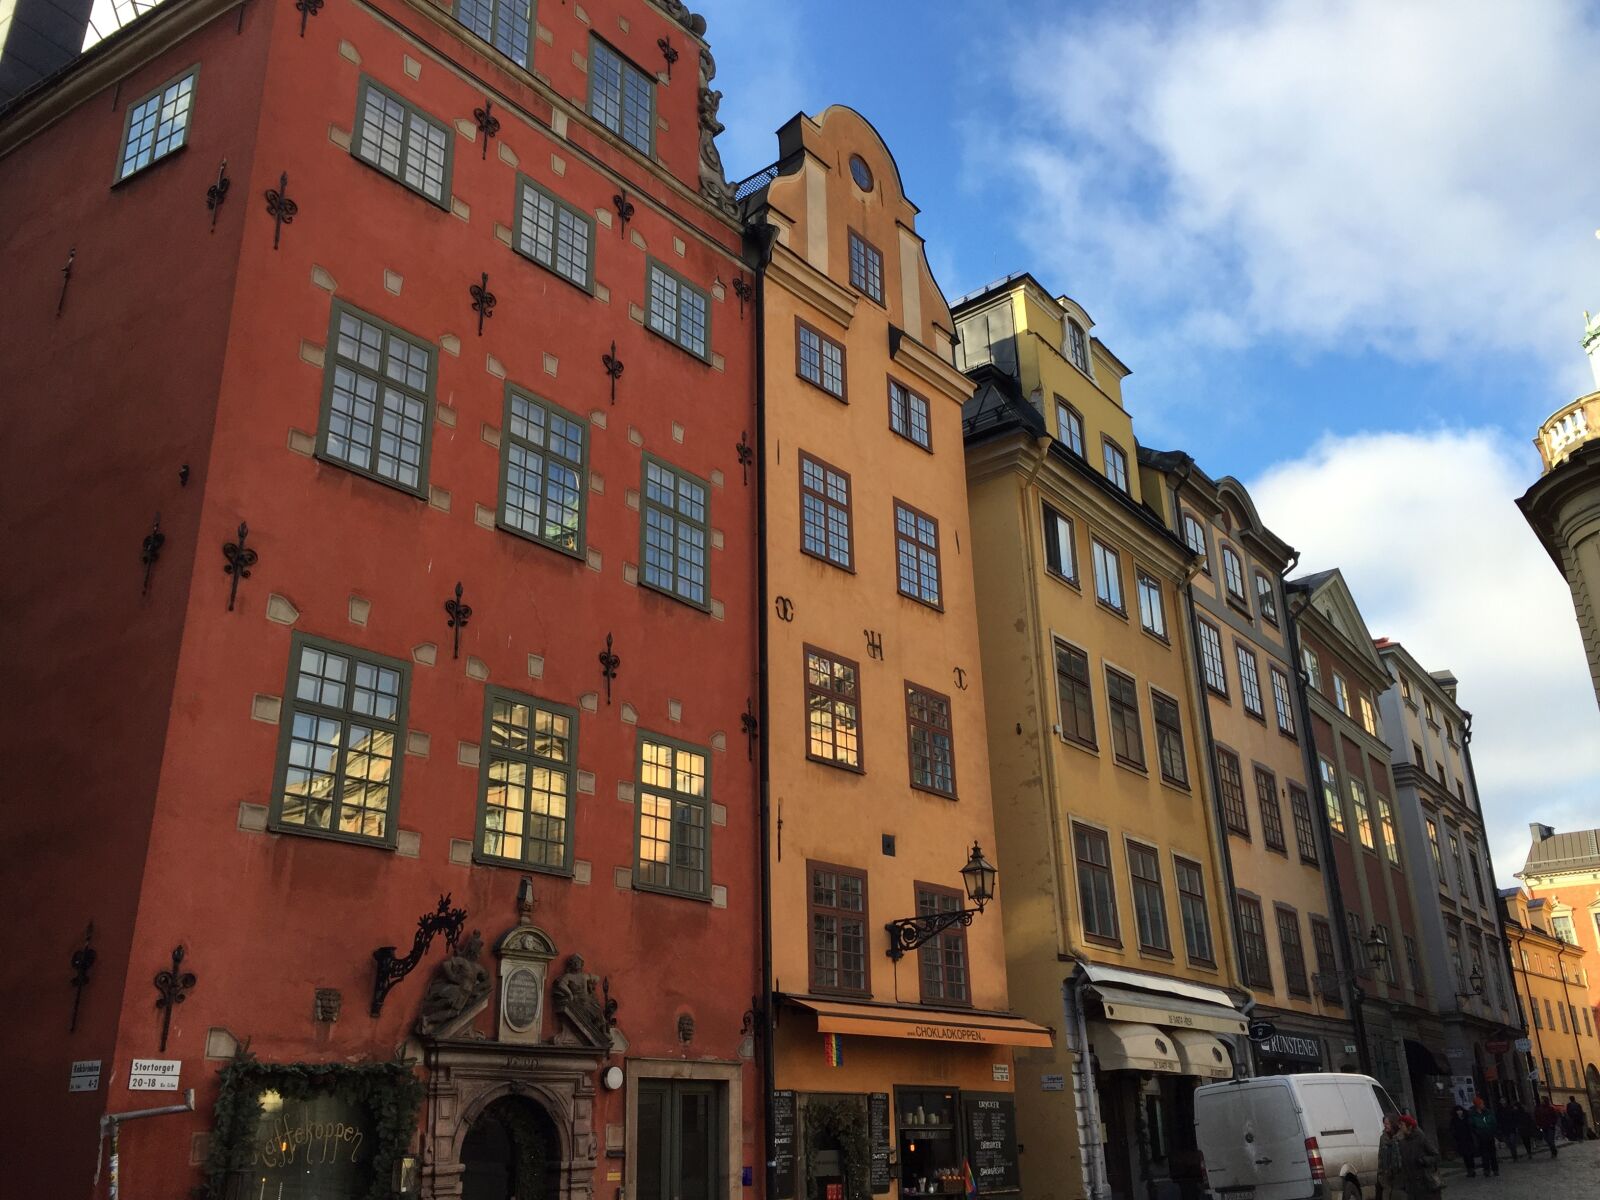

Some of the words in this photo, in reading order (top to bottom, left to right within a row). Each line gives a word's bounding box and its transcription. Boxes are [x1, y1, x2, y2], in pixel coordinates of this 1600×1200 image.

[1271, 1034, 1319, 1057] RUNSTENEN
[134, 1062, 175, 1074] Stortorget
[132, 1078, 156, 1088] 20-18
